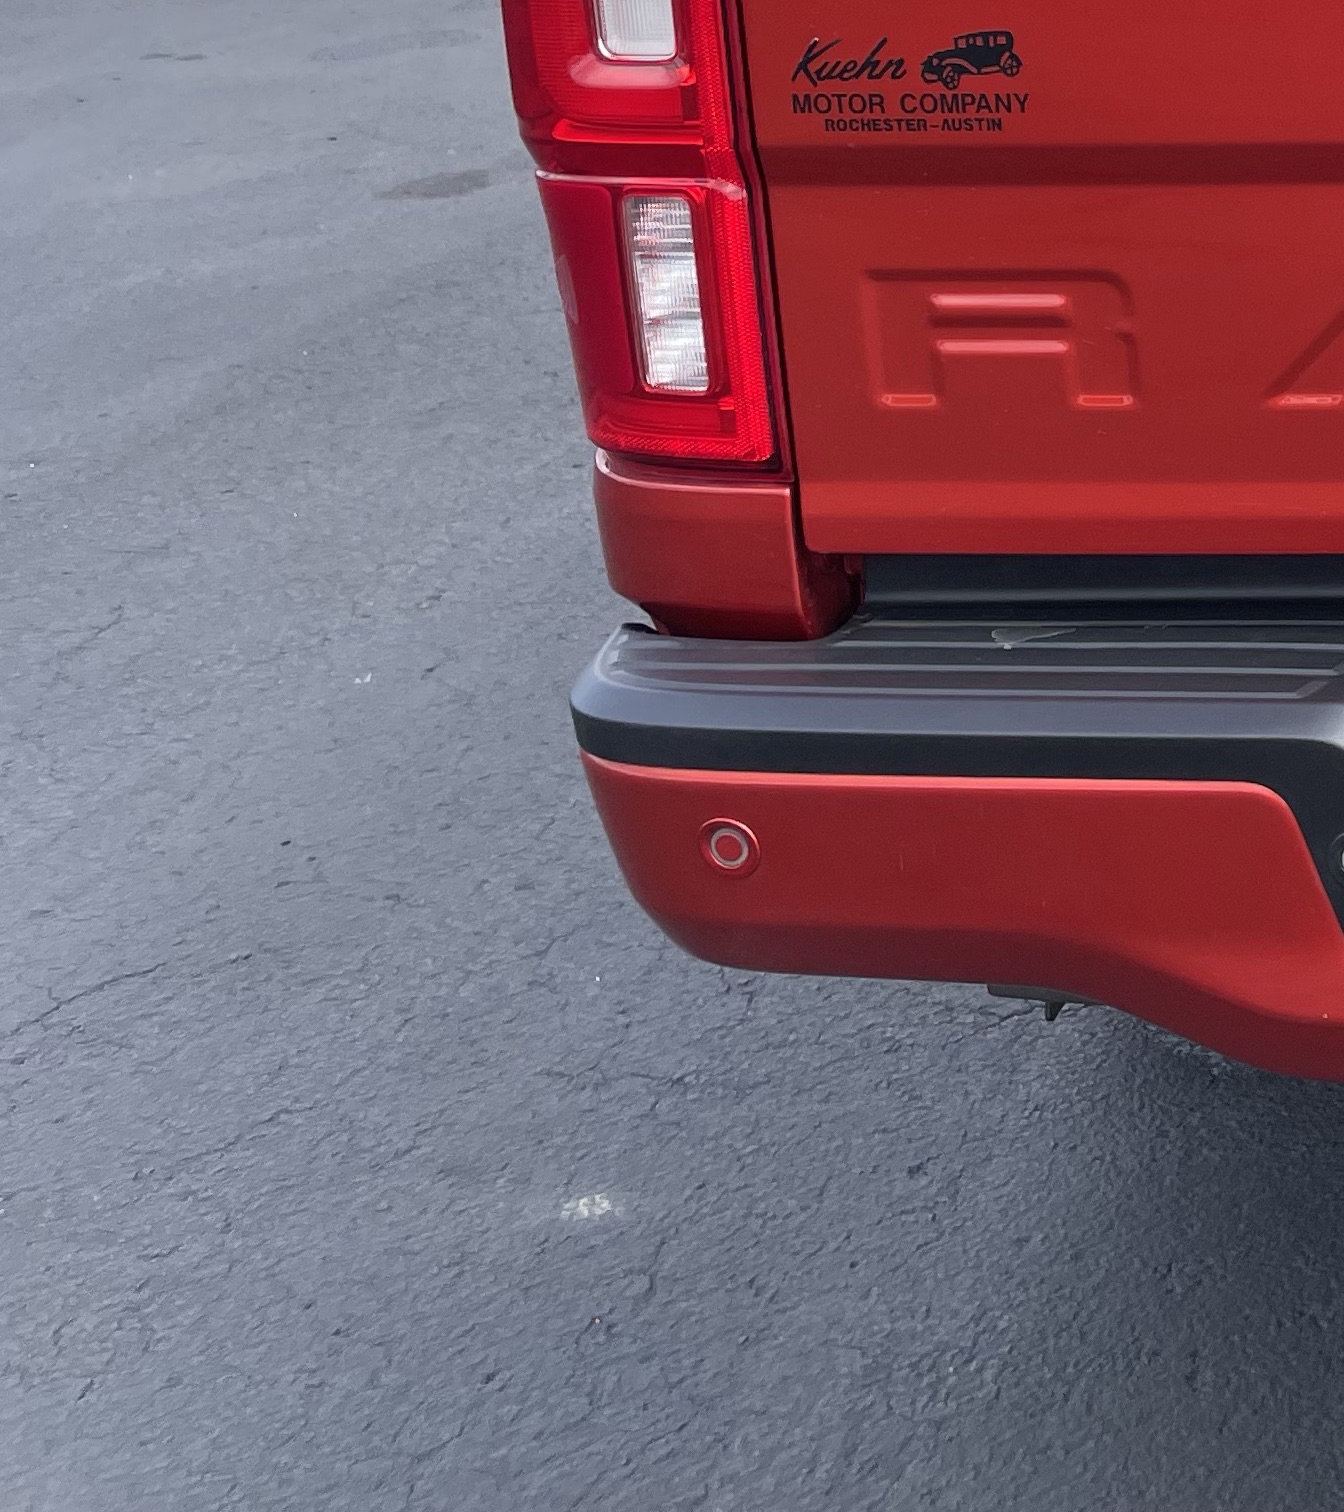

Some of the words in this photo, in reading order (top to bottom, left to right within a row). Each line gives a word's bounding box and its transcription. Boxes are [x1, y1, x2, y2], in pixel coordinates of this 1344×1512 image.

[791, 36, 907, 88] Kuehn
[791, 93, 886, 114] MOTOR
[899, 92, 1030, 114] COMPANY
